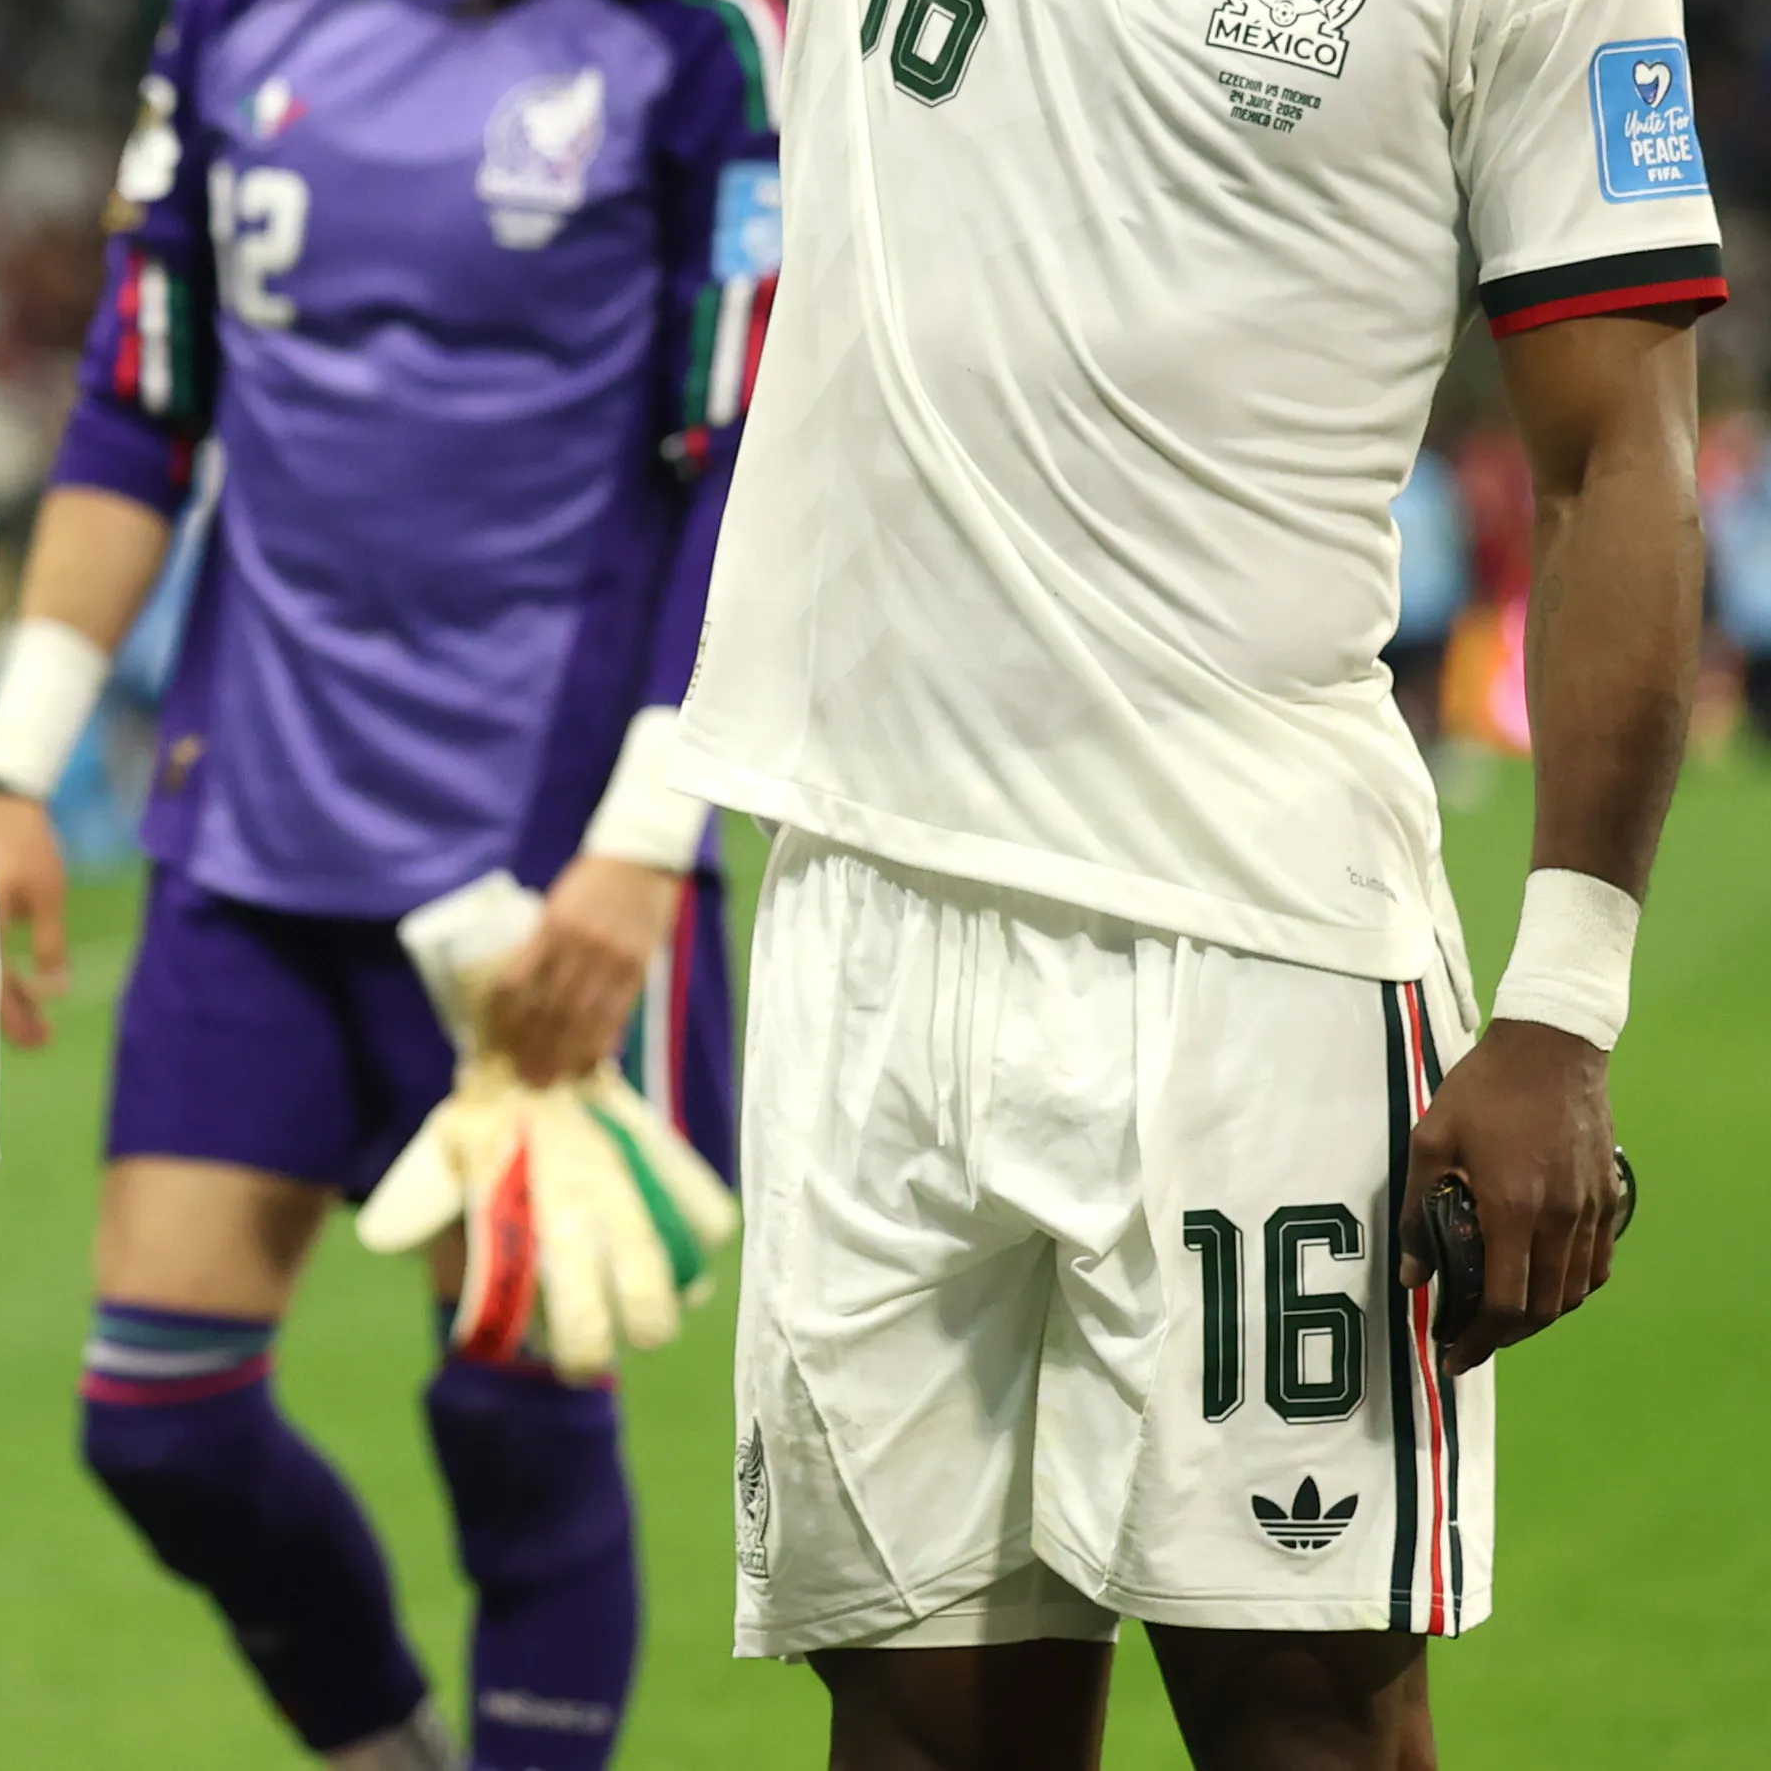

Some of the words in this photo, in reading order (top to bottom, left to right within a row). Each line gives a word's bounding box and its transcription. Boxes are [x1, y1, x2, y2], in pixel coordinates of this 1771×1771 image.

[1214, 17, 1338, 66] MÉXICO
[1218, 71, 1263, 92] CZECHIA
[1265, 83, 1279, 97] VS
[1281, 87, 1322, 109] MEXICO
[1229, 89, 1245, 104] 24
[1245, 94, 1273, 112] JUNE
[1276, 102, 1304, 121] 2026
[1230, 106, 1272, 127] MEXICO
[1272, 117, 1295, 134] CITY
[1624, 109, 1666, 138] Unite
[1664, 106, 1691, 135] For
[1630, 134, 1693, 167] PEACE
[1648, 166, 1682, 182] FIFA
[205, 159, 312, 327] 12
[1183, 1203, 1368, 1425] 16
